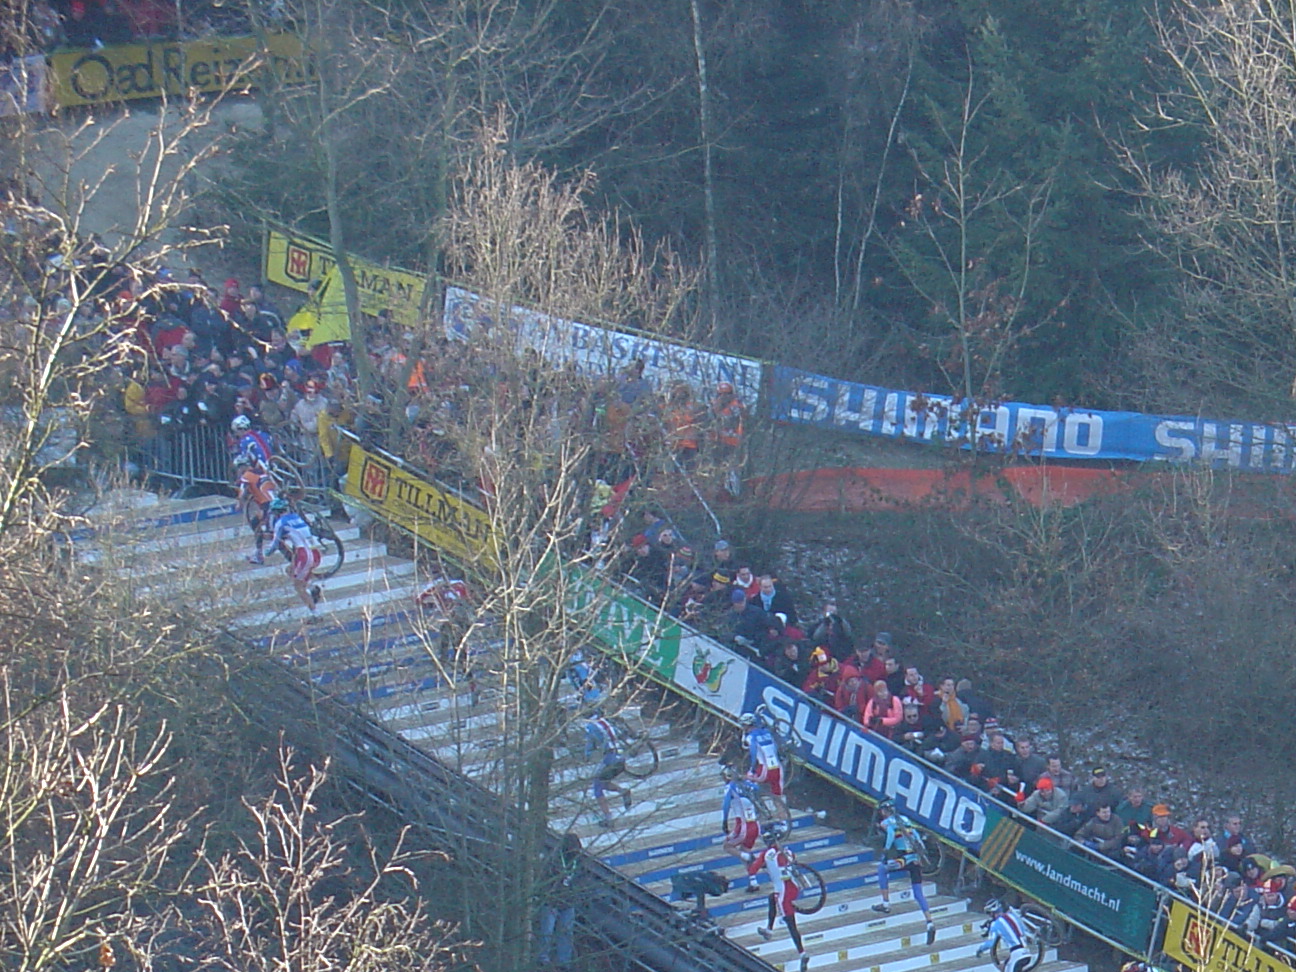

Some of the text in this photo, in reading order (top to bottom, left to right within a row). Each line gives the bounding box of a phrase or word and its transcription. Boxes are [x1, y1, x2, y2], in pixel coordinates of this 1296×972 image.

[70, 50, 154, 99] Oad
[318, 255, 414, 302] TMAN
[790, 373, 1104, 456] SHIMANO
[762, 686, 986, 843] SHIMANO
[1014, 850, 1121, 912] www.landmacht.nl
